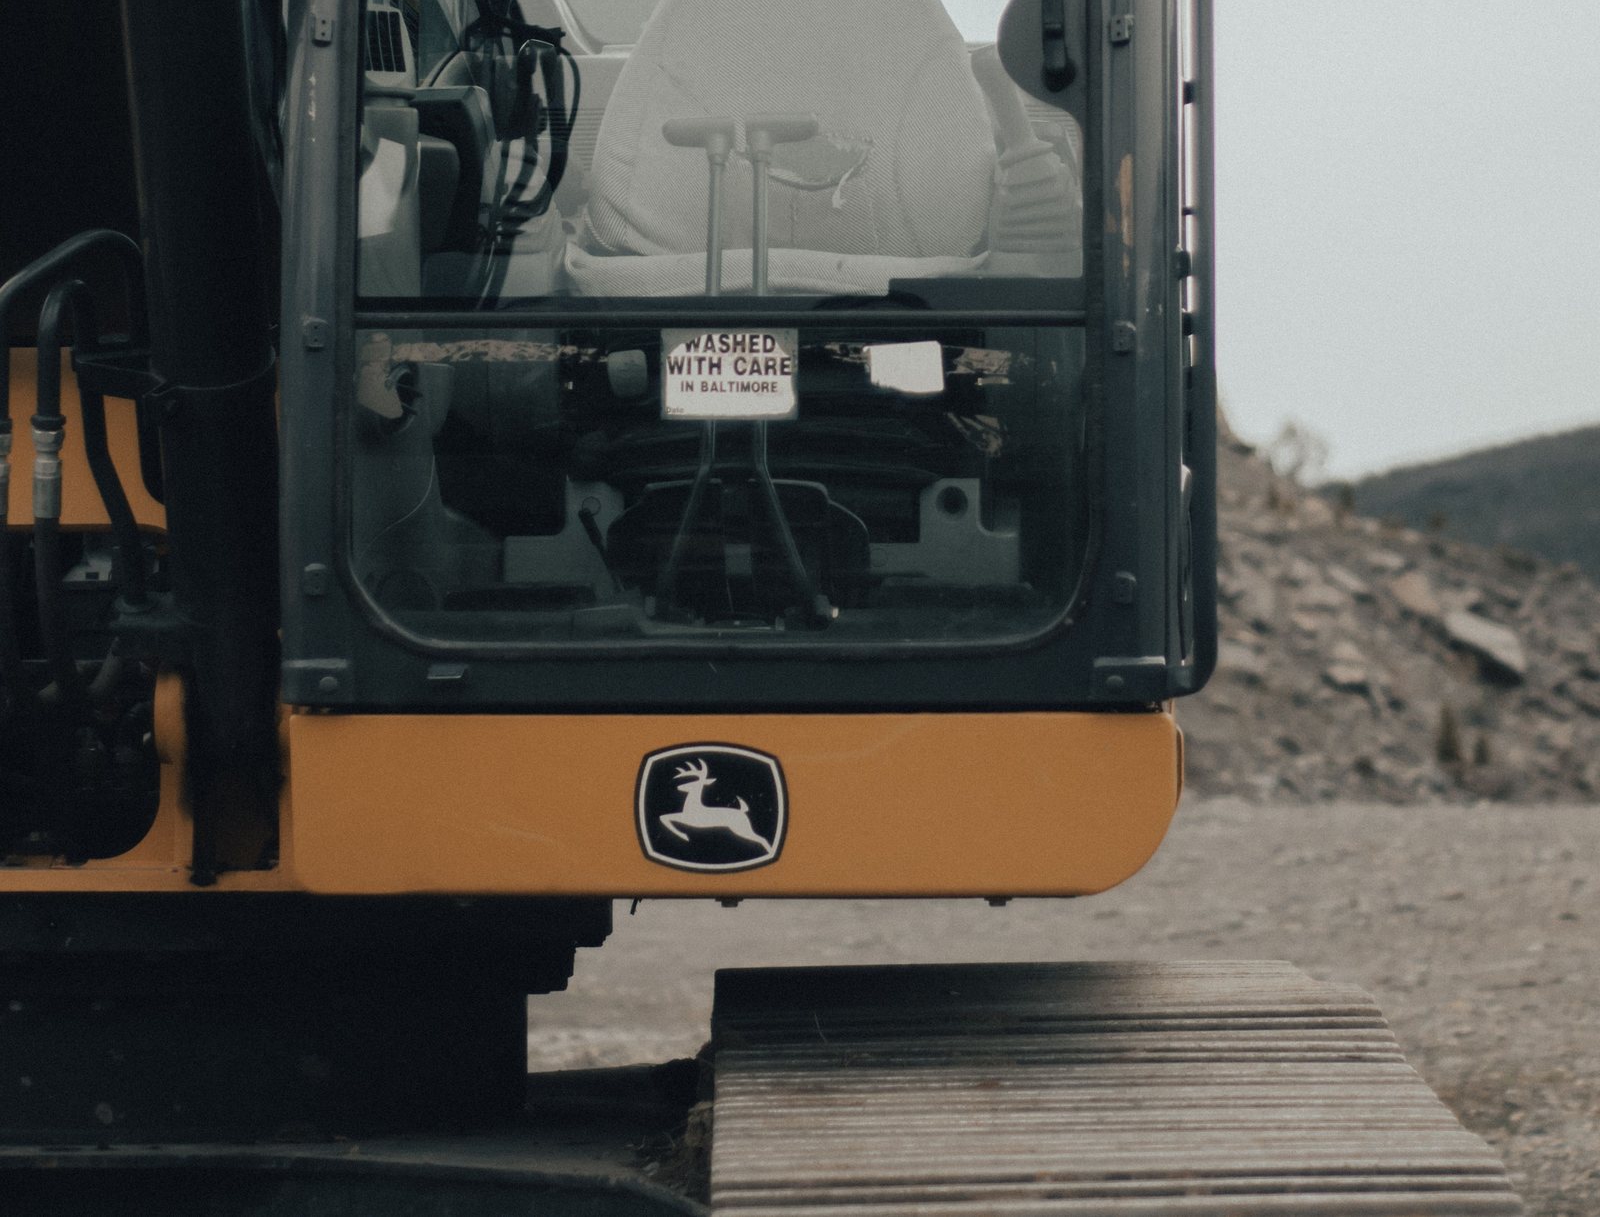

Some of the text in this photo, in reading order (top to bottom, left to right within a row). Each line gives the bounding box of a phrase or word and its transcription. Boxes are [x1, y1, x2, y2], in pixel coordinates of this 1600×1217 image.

[685, 334, 776, 353] WASHED
[667, 356, 792, 376] WITH CARE
[680, 381, 778, 393] IN BALTIMORE
